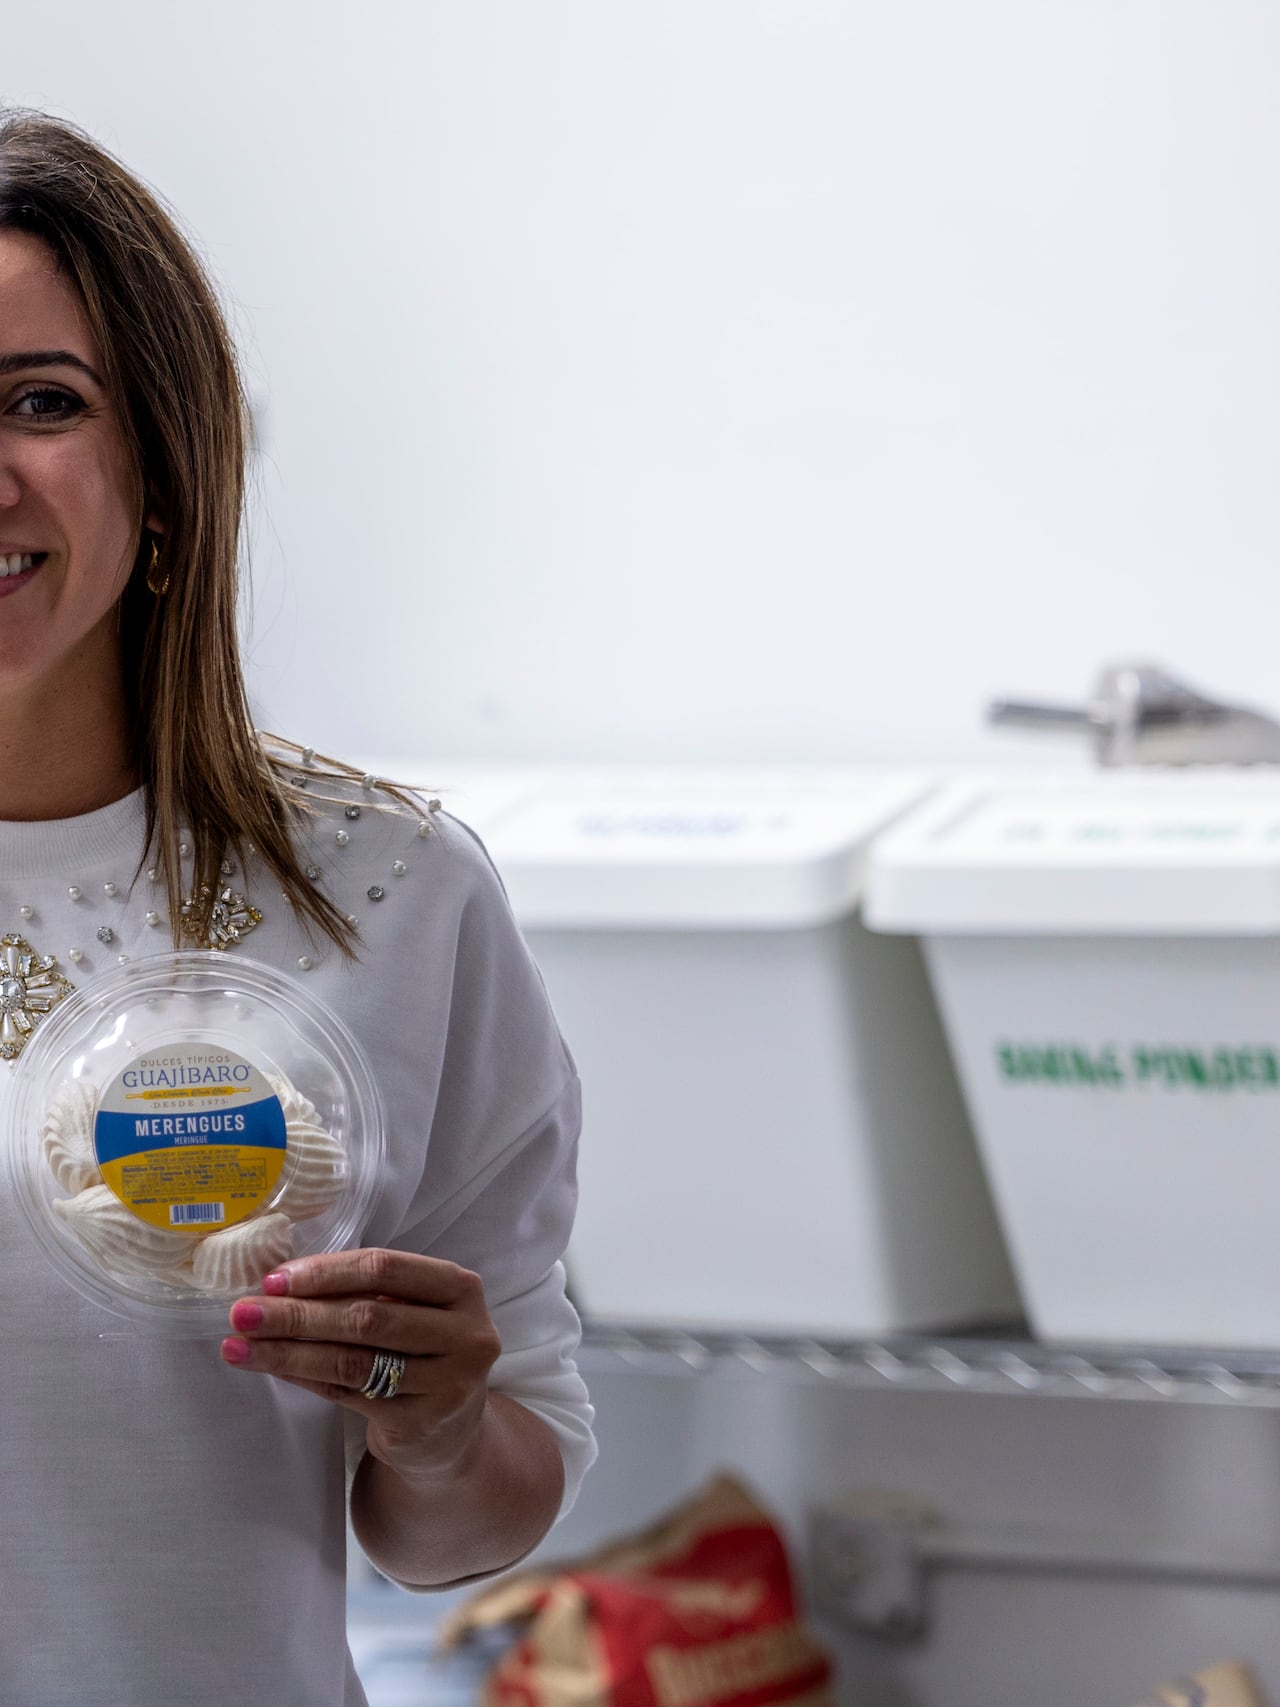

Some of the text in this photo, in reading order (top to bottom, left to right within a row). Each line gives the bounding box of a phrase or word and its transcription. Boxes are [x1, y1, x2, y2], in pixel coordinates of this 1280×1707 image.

[140, 1057, 182, 1068] DULCES
[994, 1040, 1123, 1088] BAKING
[122, 1064, 250, 1088] GUAJÍBARO
[153, 1100, 195, 1109] DESDE
[135, 1114, 246, 1137] MERENGUES
[174, 1135, 208, 1145] MERINGUE
